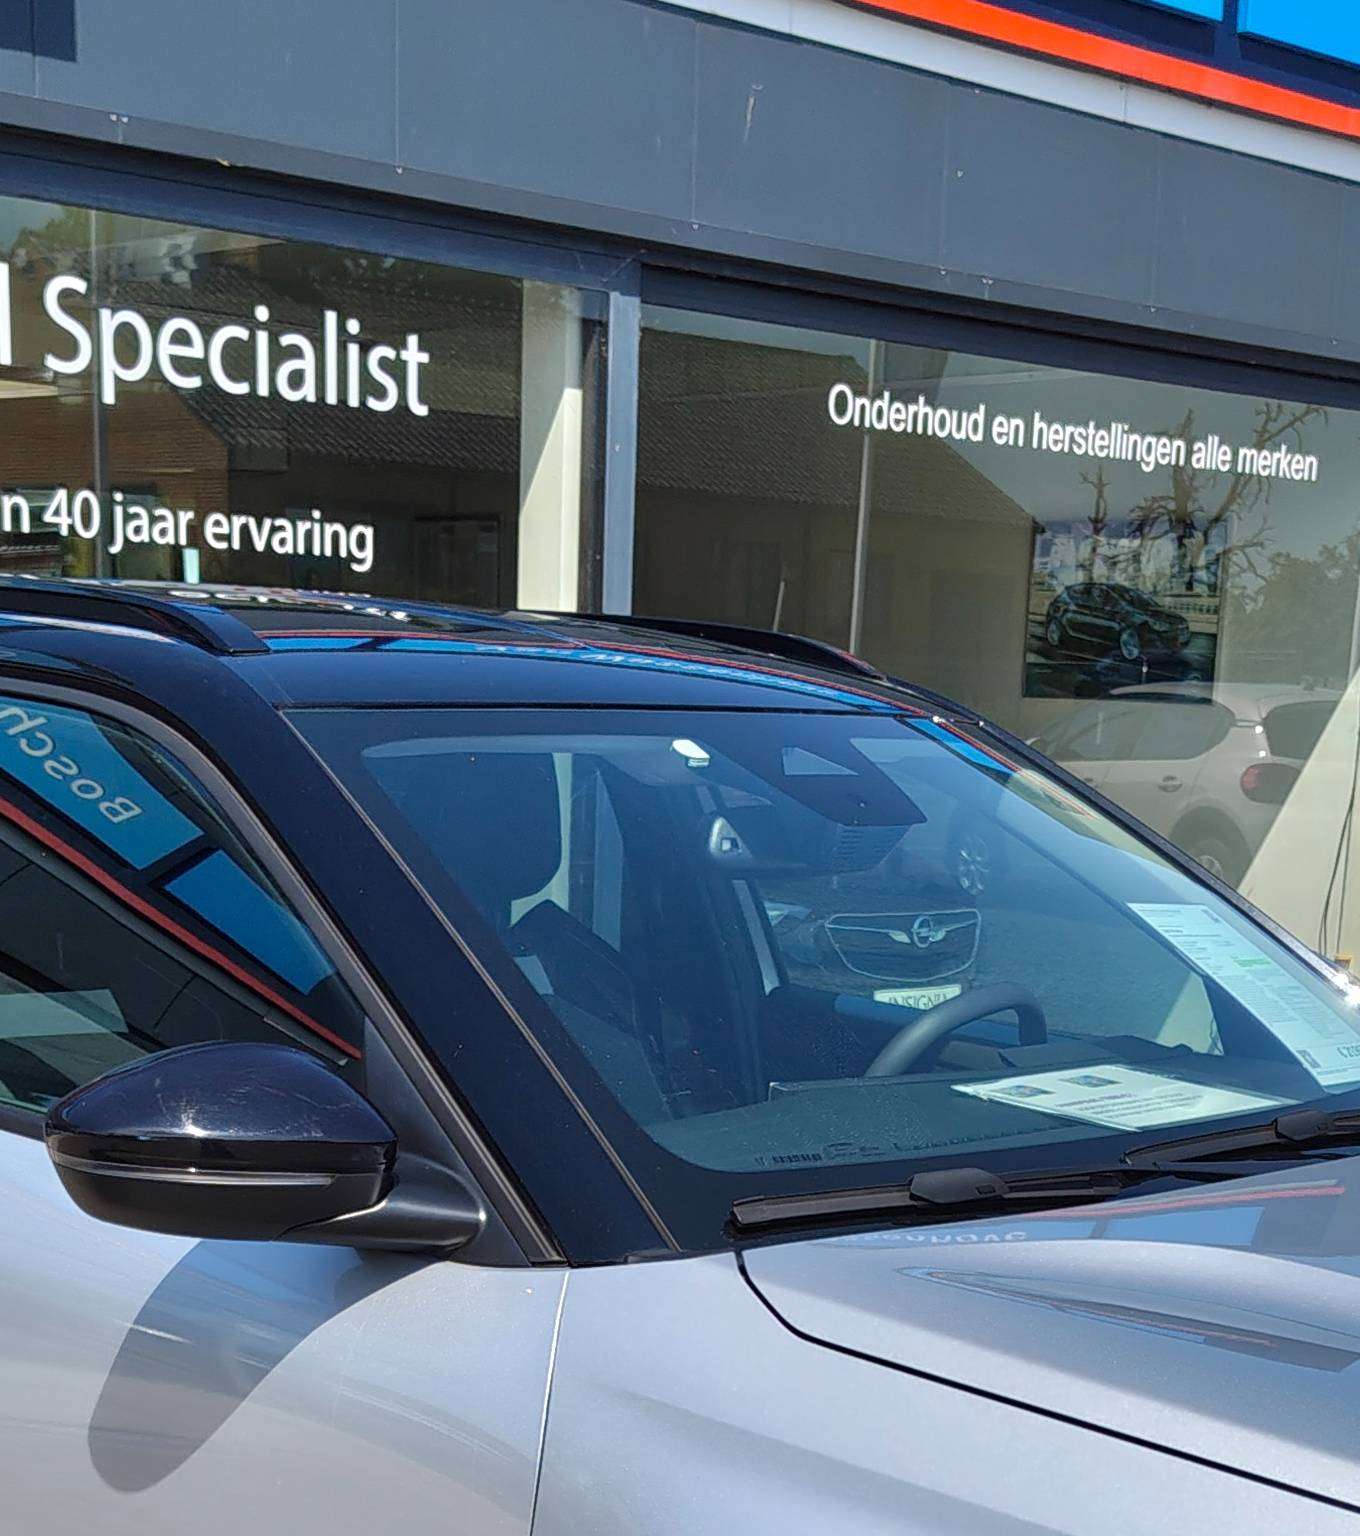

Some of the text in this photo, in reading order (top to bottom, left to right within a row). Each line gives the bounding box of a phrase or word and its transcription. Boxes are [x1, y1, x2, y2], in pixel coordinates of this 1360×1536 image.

[42, 274, 431, 416] Specialist
[828, 383, 1320, 482] Onderhoud en herstellingen alle merken
[43, 488, 101, 540] 40
[108, 492, 196, 556] jaar
[203, 507, 377, 574] ervaring
